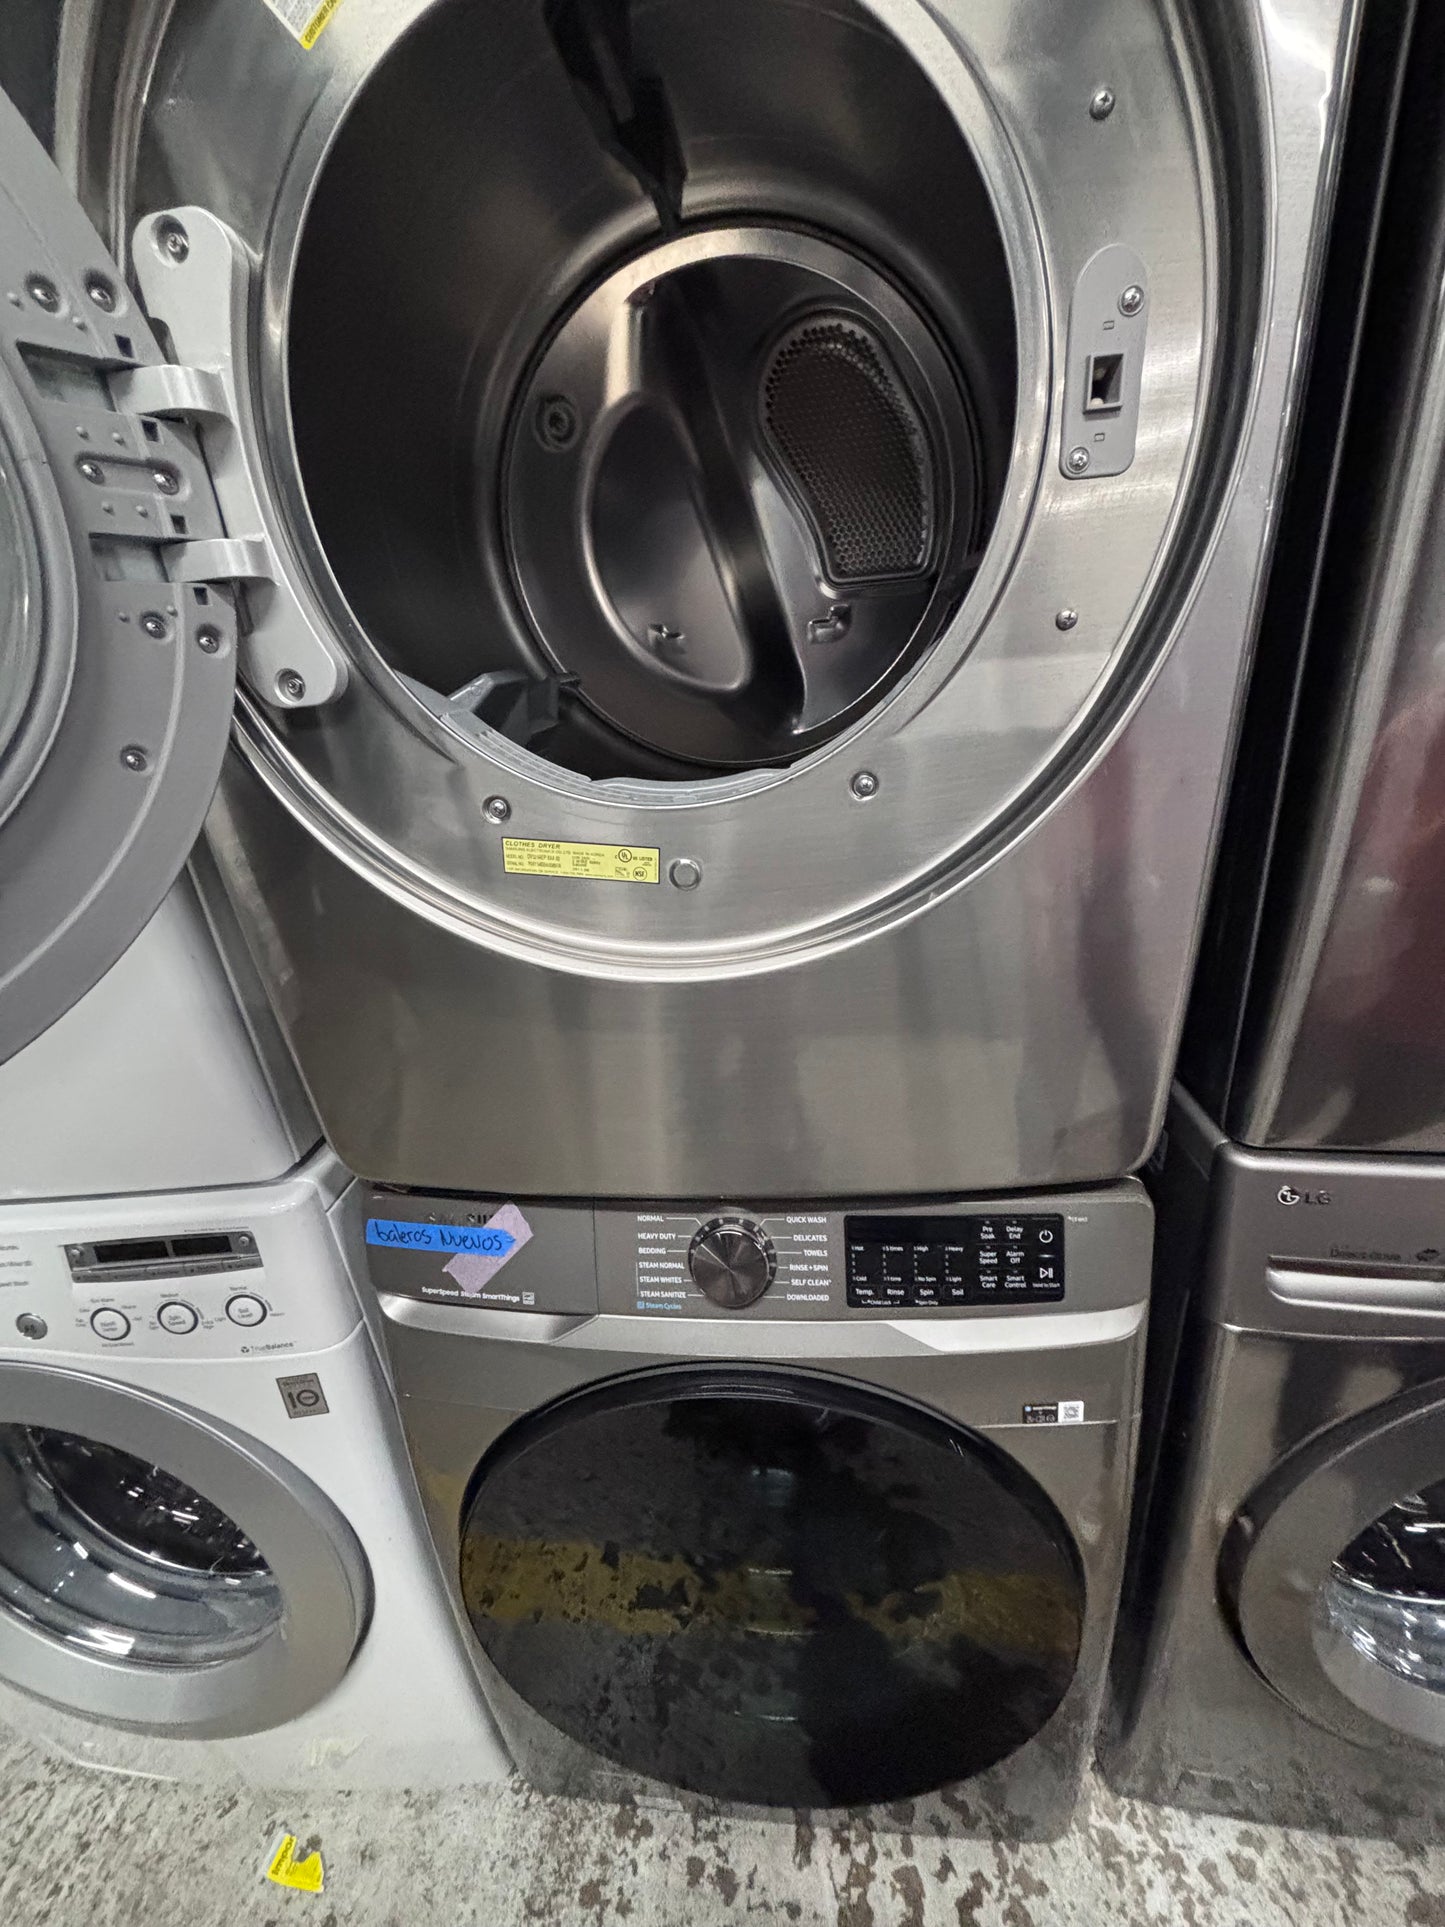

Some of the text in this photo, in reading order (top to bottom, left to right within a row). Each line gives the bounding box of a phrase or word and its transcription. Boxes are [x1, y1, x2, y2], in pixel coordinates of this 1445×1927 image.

[505, 840, 561, 850] CLOTHES DRYER
[786, 1216, 806, 1224] QUICK
[793, 1234, 828, 1242] DELICATES
[979, 1257, 998, 1265] Speed
[661, 1276, 682, 1284] WHITES
[791, 1278, 807, 1286] SELF
[640, 1290, 660, 1298] STEAM
[855, 1287, 875, 1296] Temp.
[952, 1288, 964, 1296] Soil
[482, 1292, 520, 1303] SmartThings
